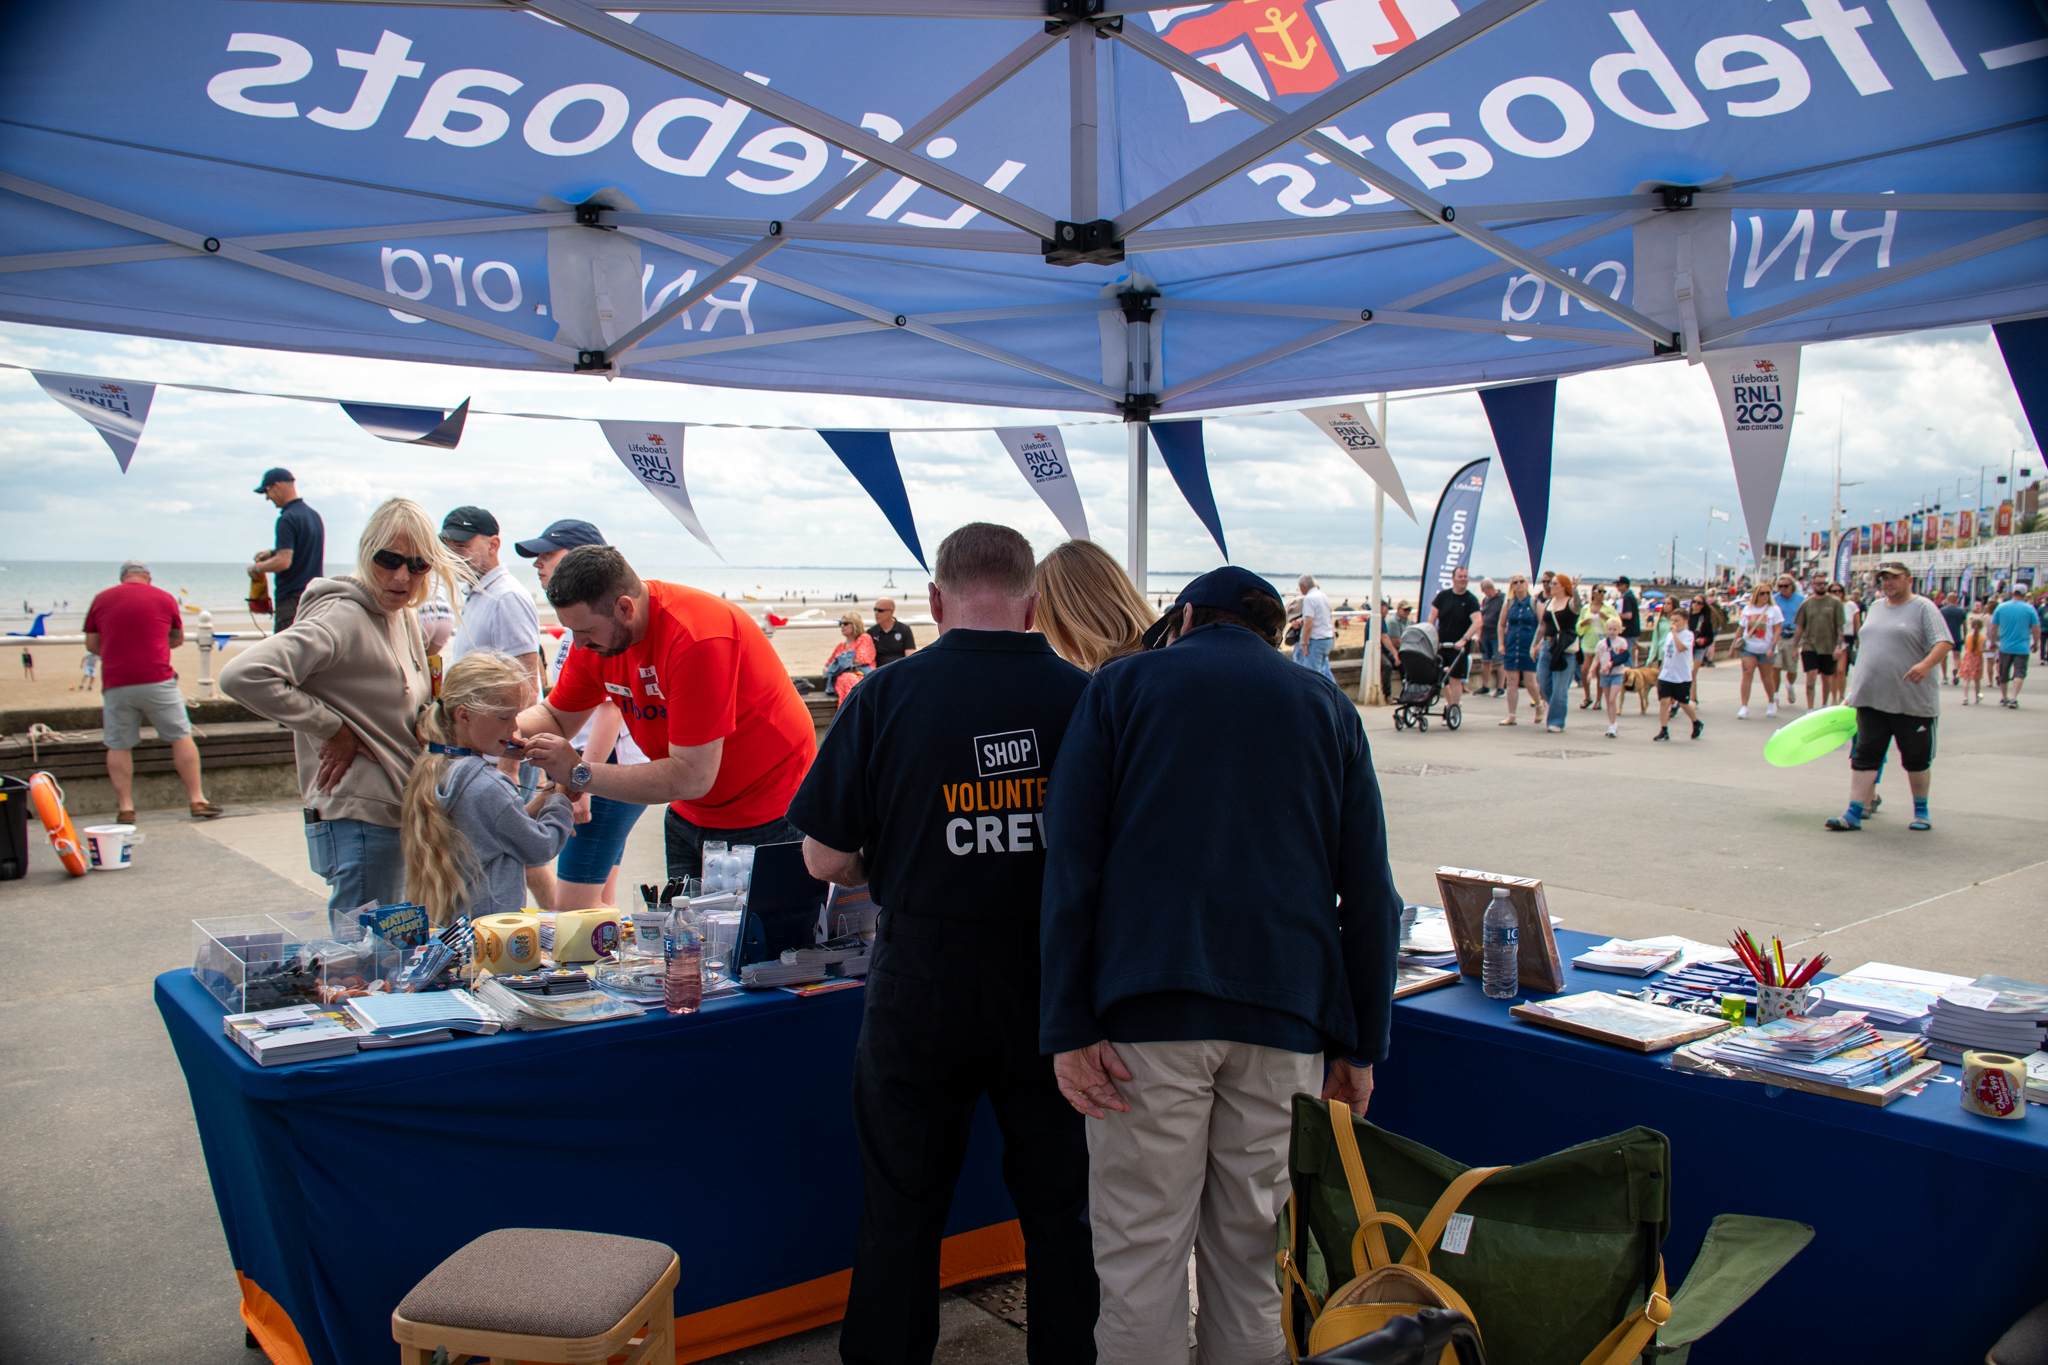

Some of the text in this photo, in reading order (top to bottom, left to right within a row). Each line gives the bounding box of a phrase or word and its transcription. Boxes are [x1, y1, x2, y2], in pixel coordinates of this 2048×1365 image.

[1732, 373, 1779, 384] Lifeboats
[69, 387, 128, 400] Lifeboats
[1734, 385, 1782, 403] RNLI
[1333, 426, 1369, 436] RNLI
[628, 443, 668, 454] Lifeboats
[1020, 441, 1052, 451] Lifeboats
[631, 453, 672, 470] RNLI
[1024, 449, 1058, 465] RNLI
[1437, 509, 1468, 595] dlington
[983, 739, 1032, 768] SHOP
[942, 777, 1049, 813] VOLUNTE
[378, 909, 416, 930] WATER
[392, 918, 425, 935] SMART
[1988, 1075, 2006, 1109] CALL 999
